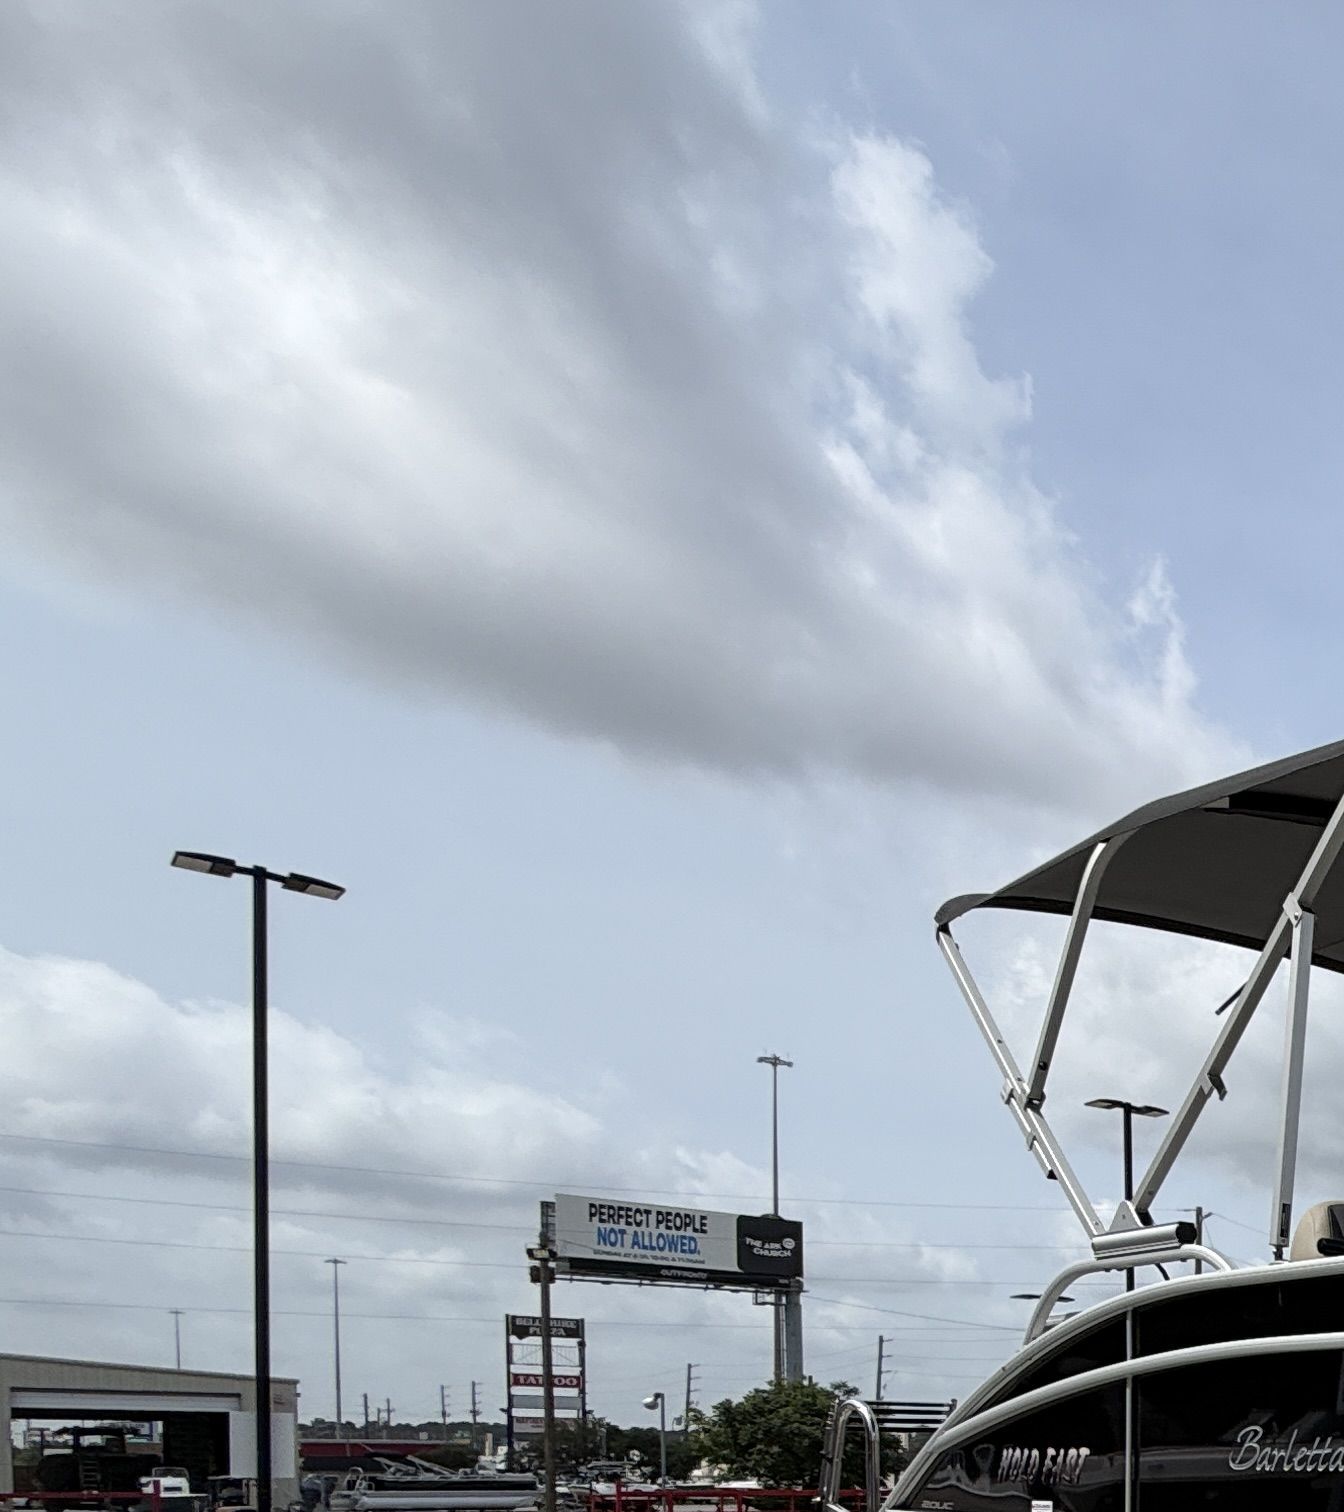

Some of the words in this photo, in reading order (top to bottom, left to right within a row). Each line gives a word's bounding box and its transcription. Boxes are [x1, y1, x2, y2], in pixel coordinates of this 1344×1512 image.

[588, 1203, 651, 1228] PERFECT
[655, 1211, 707, 1234] PEOPLE
[597, 1227, 626, 1248] NOT
[631, 1230, 701, 1256] ALLOWED.
[753, 1247, 792, 1257] CHURCH
[528, 1326, 567, 1336] PLZA
[517, 1375, 577, 1386] TATOO
[997, 1446, 1040, 1484] HOLD
[1041, 1446, 1090, 1485] FAST
